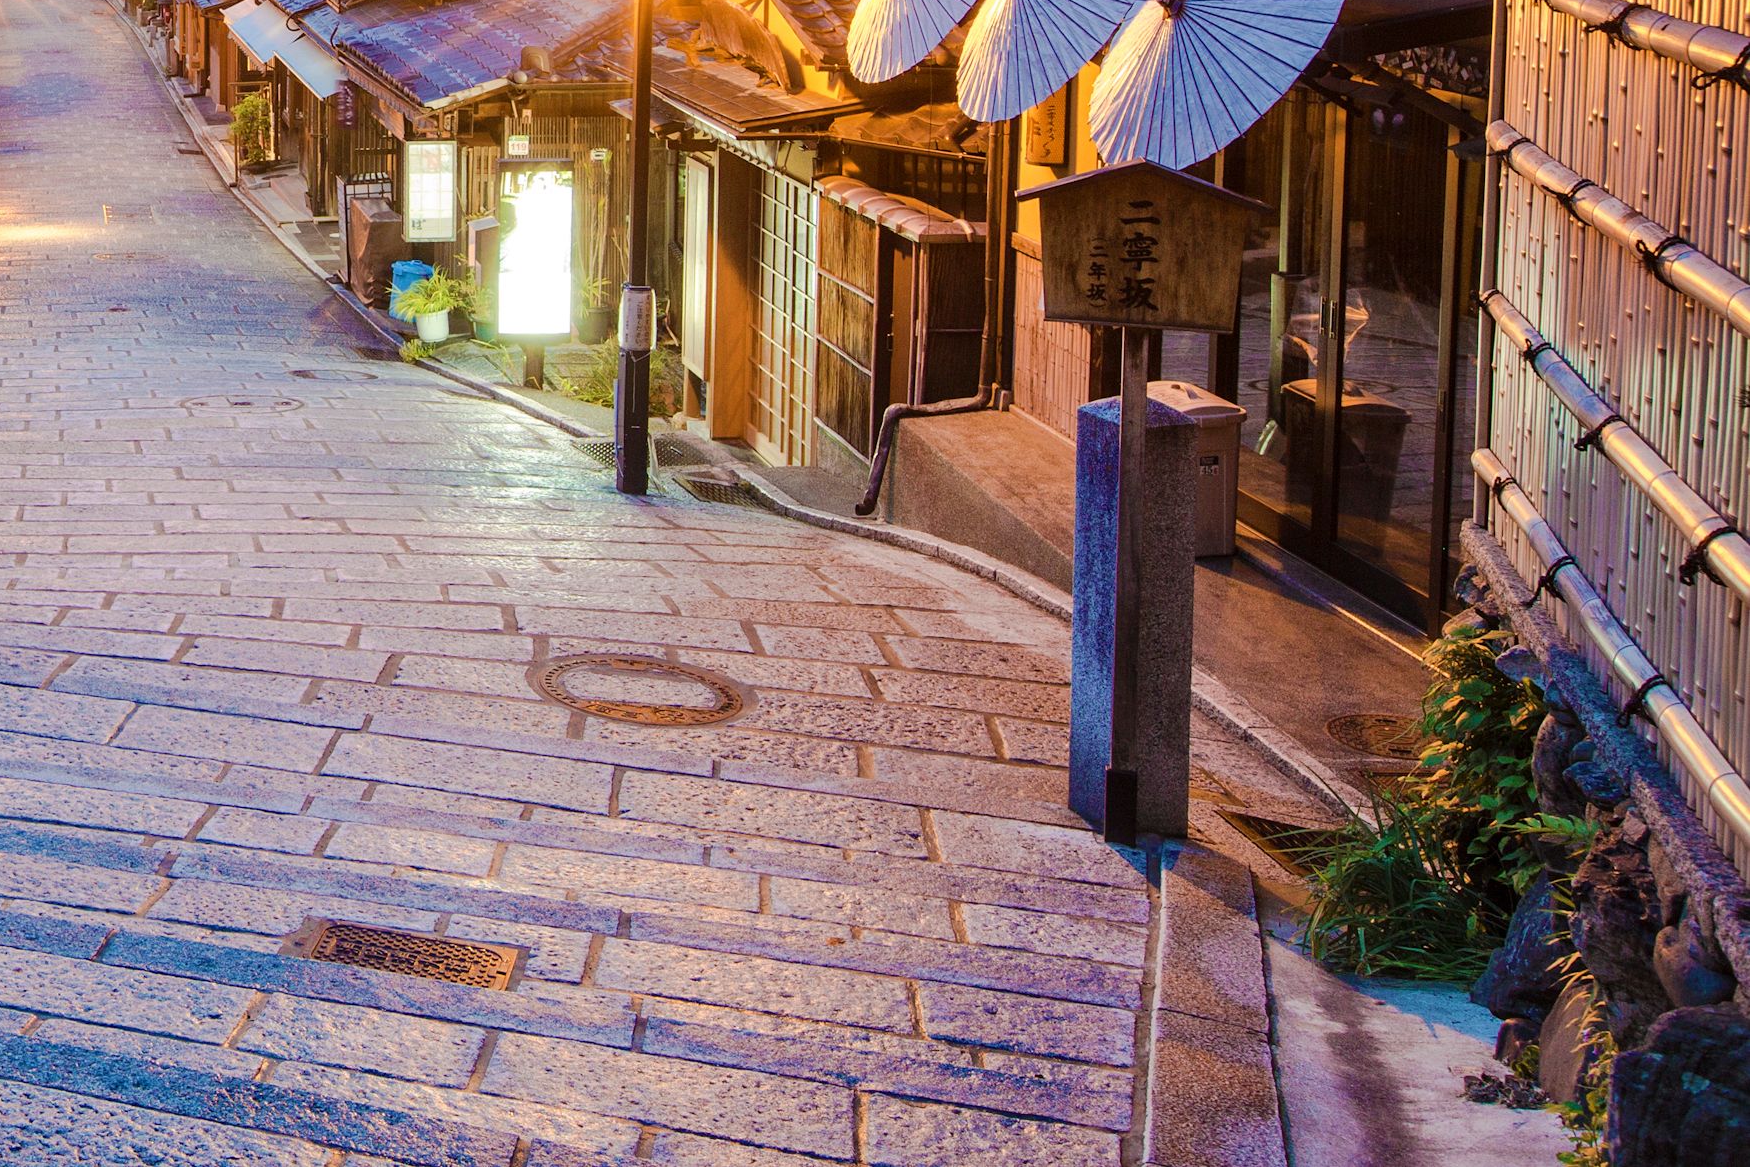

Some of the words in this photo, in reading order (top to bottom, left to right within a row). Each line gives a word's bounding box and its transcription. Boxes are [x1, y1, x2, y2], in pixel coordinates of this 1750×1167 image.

[1086, 236, 1109, 309] (二年坂)
[1118, 200, 1161, 312] 二寧坂
